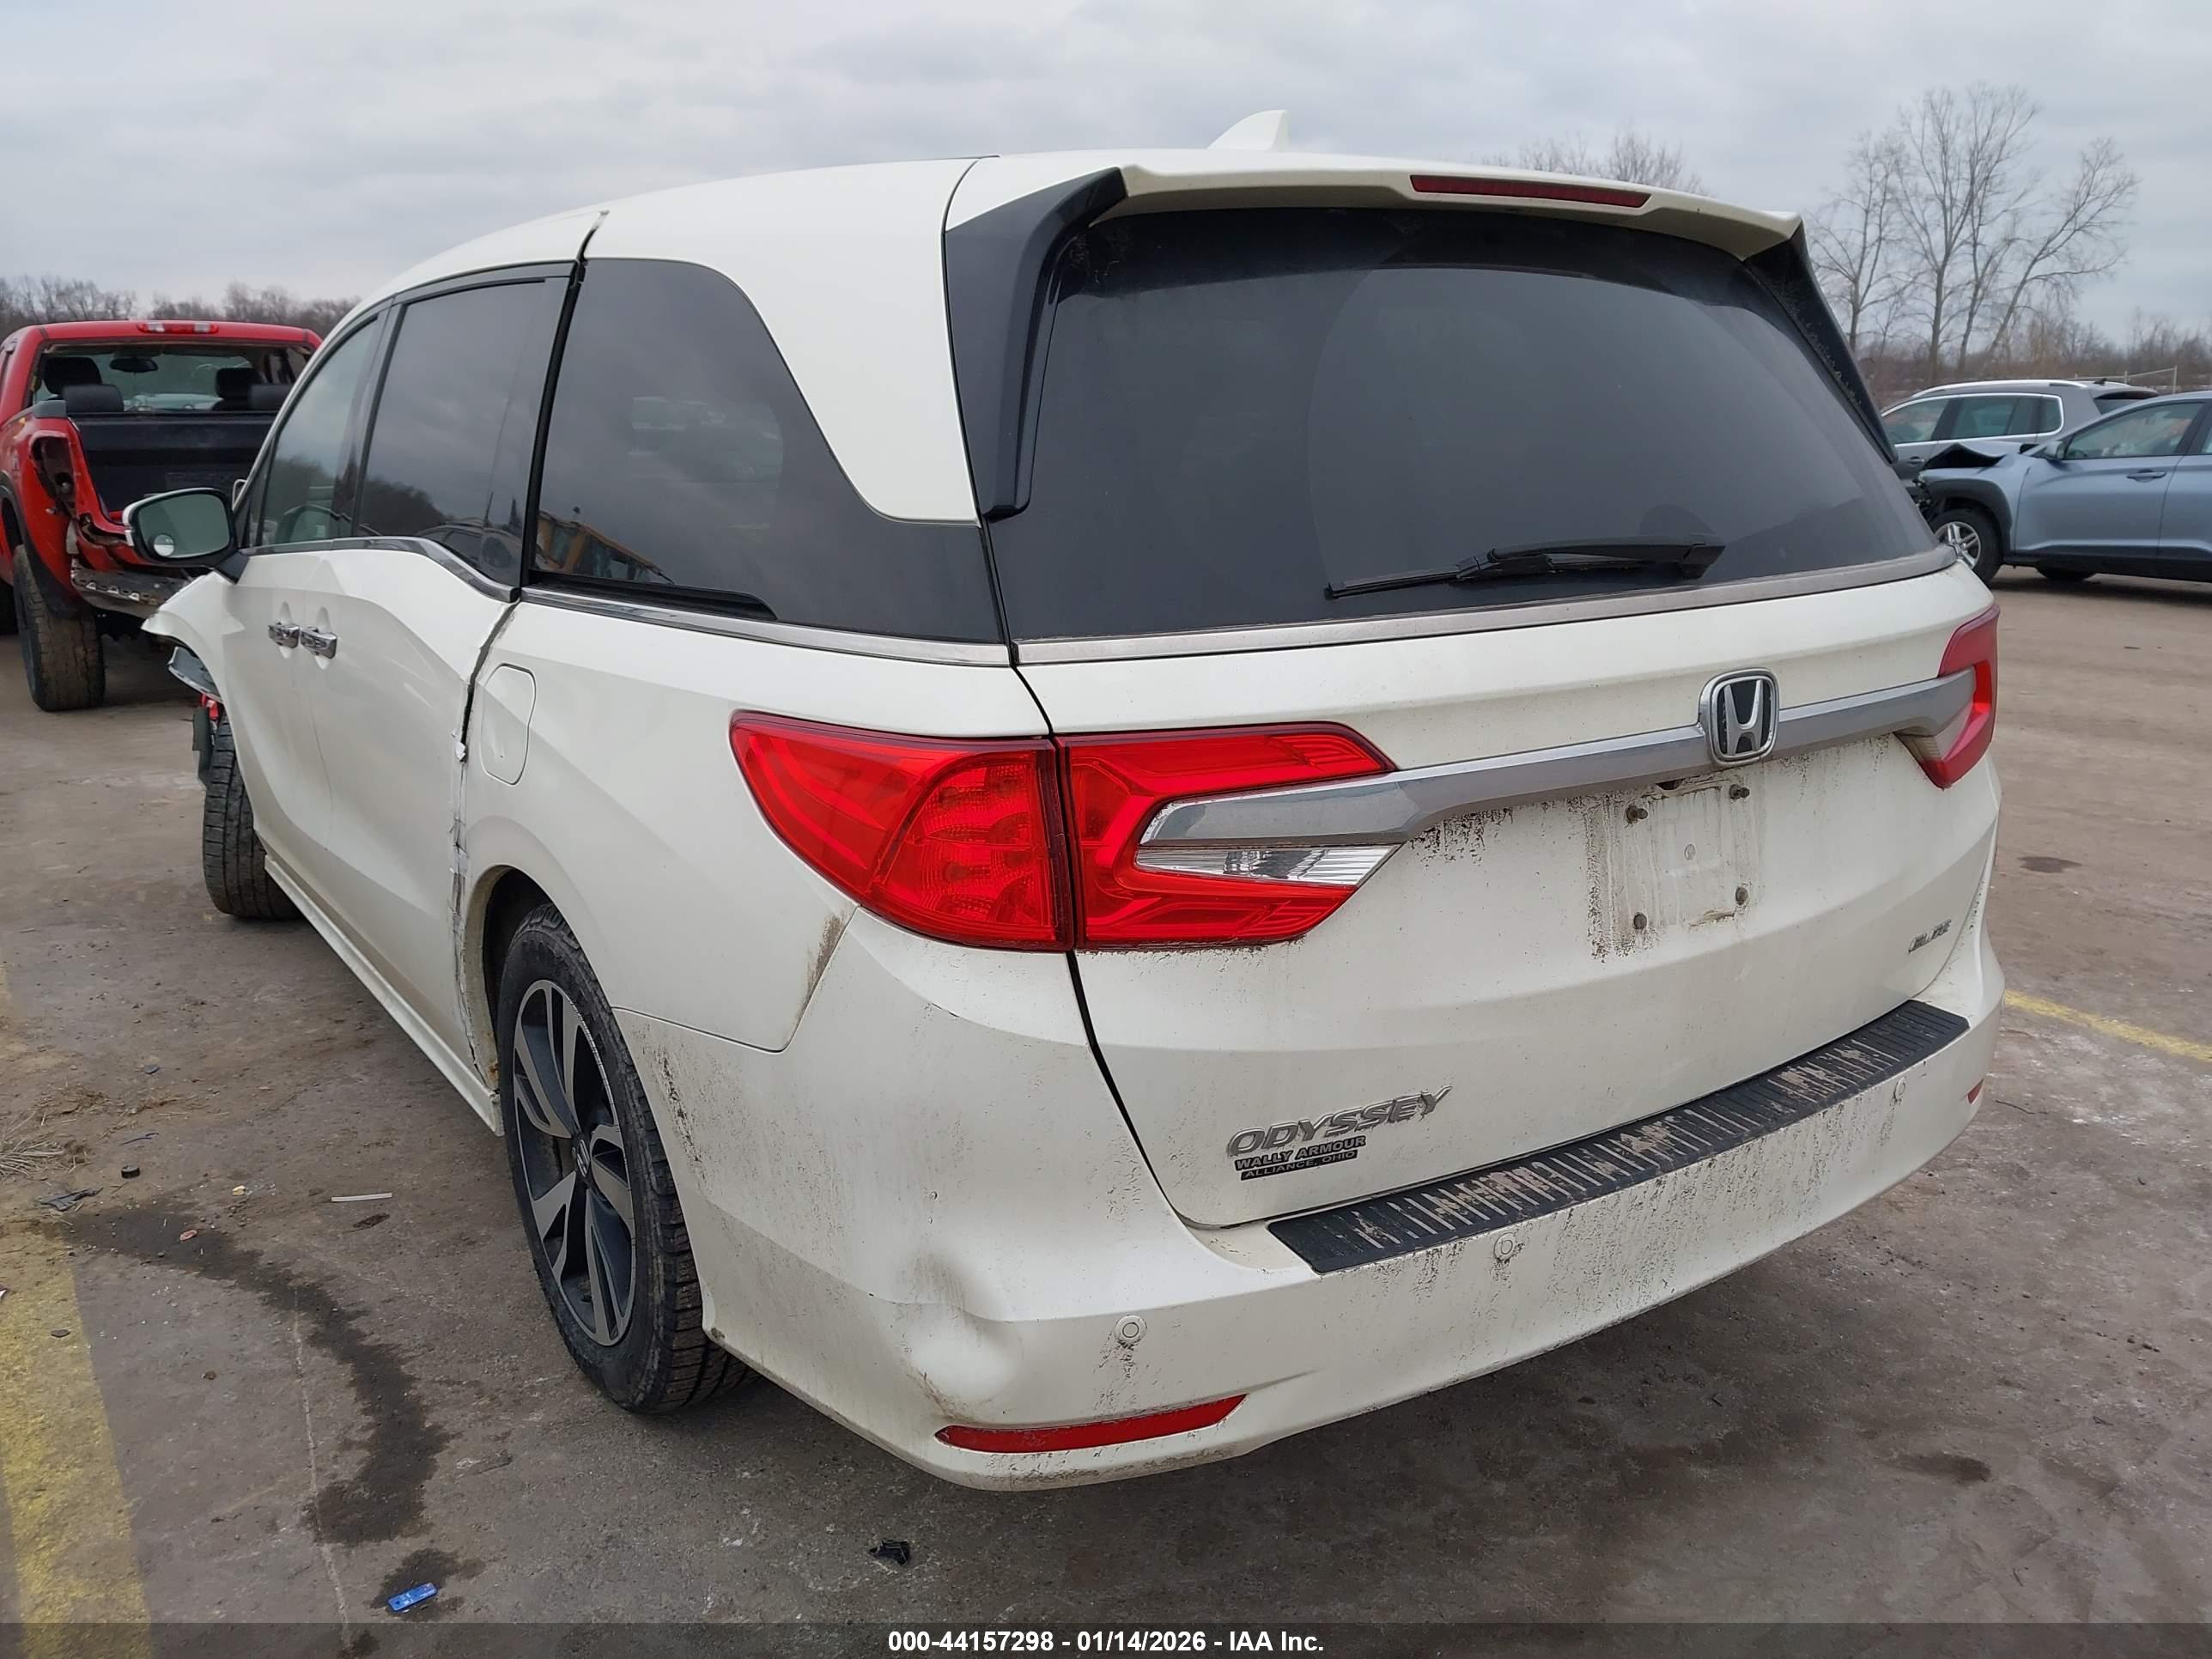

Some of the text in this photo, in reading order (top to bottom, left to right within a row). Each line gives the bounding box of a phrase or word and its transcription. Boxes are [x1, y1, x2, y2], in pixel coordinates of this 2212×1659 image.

[1227, 1085, 1453, 1155] ODYSSEY
[1236, 1136, 1366, 1170] WALLY ARMOUR
[1322, 1151, 1355, 1164] OHIO
